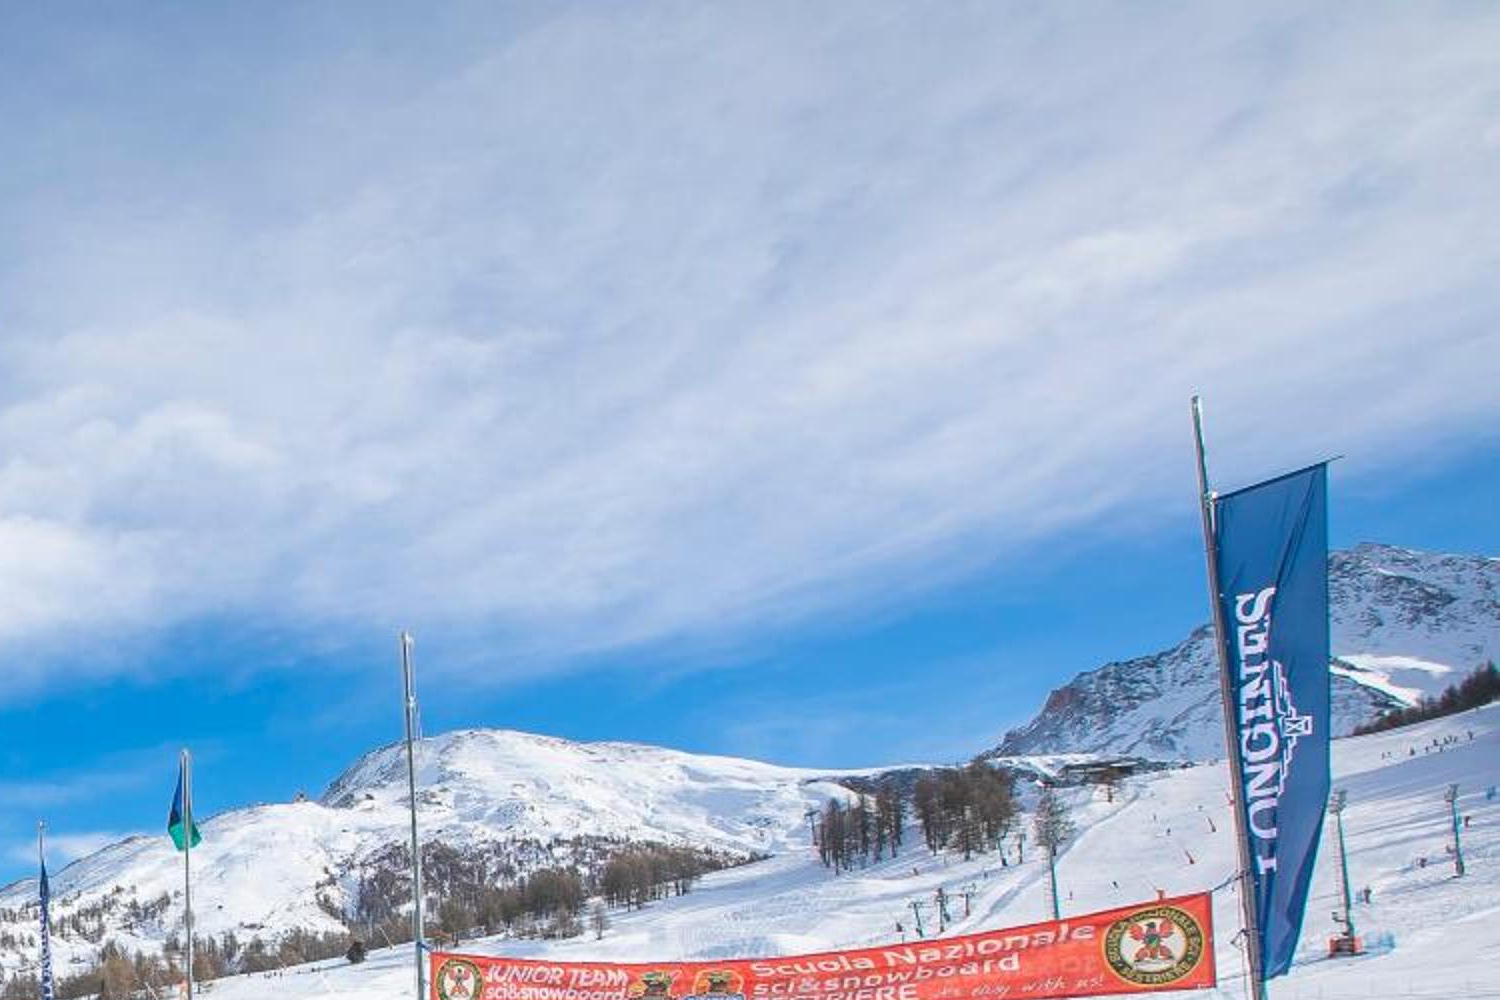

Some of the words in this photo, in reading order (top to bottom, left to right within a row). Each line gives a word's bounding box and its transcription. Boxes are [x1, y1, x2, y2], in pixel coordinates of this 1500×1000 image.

[751, 955, 873, 977] Scuola
[883, 924, 1096, 966] Nazionale
[485, 964, 564, 984] JUNIOR
[569, 968, 629, 987] TEAM
[753, 953, 1020, 995] sci&snowboard
